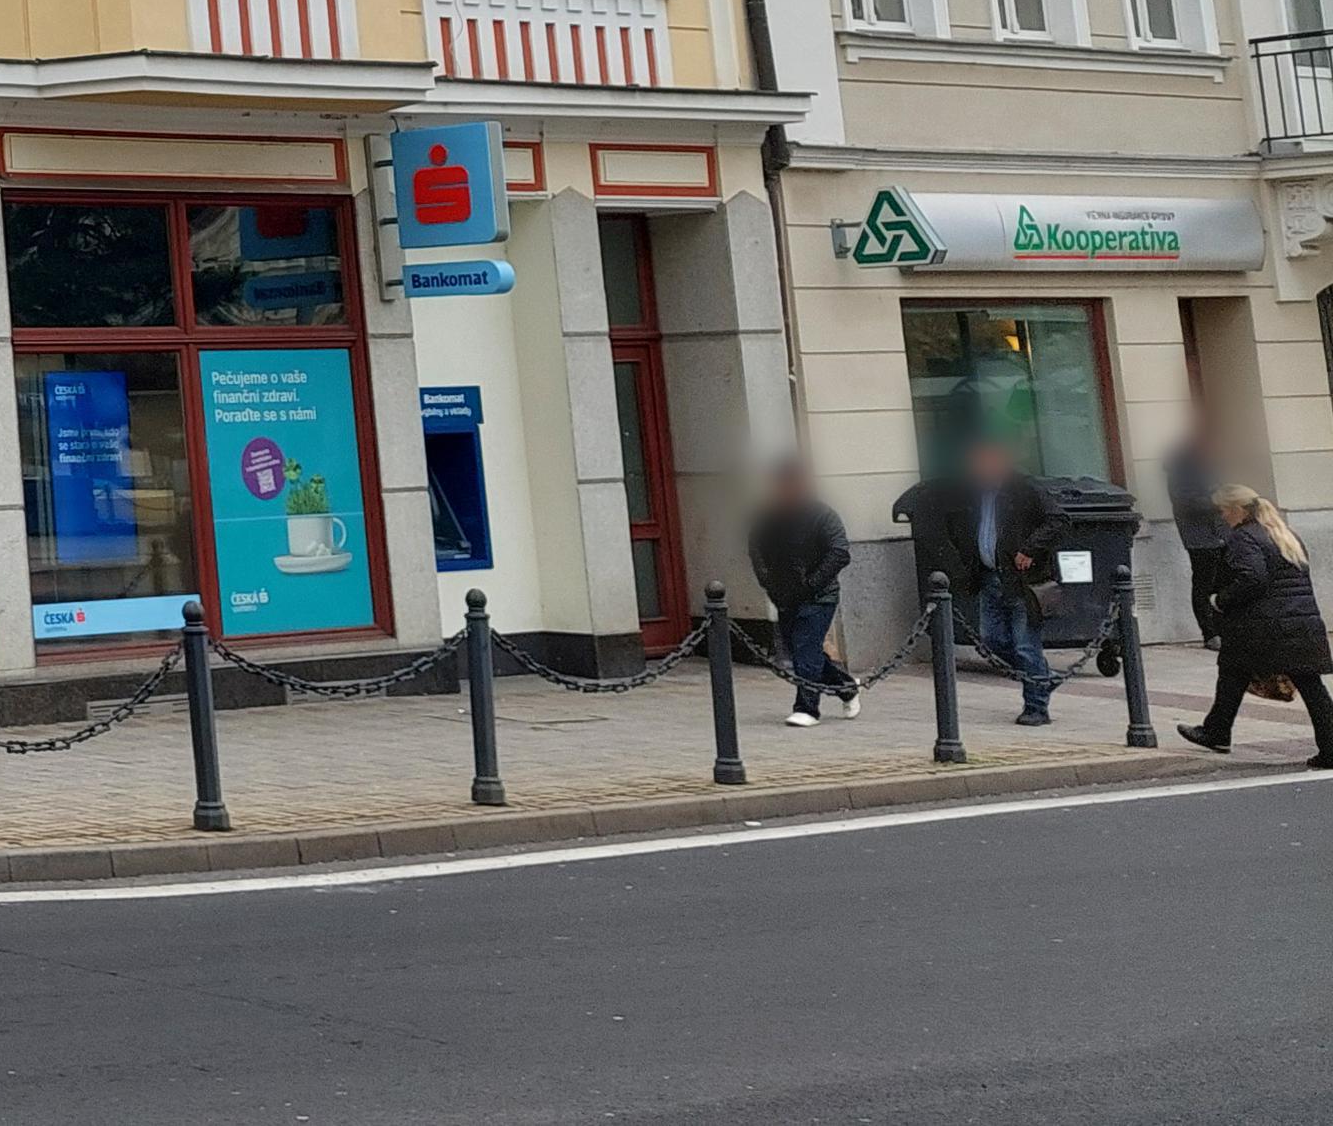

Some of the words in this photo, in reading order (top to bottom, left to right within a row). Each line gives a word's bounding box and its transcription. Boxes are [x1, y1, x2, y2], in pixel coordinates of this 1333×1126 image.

[1047, 223, 1180, 259] Kooperativa
[411, 270, 489, 289] Bankomat
[212, 371, 268, 388] Pečujeme
[270, 375, 278, 385] o
[281, 370, 308, 384] vaše
[213, 389, 260, 404] finanční
[215, 408, 261, 423] Poraďte
[263, 411, 277, 421] se
[279, 411, 287, 421] s
[289, 407, 317, 421] námi
[44, 610, 75, 625] ČESKÁ
